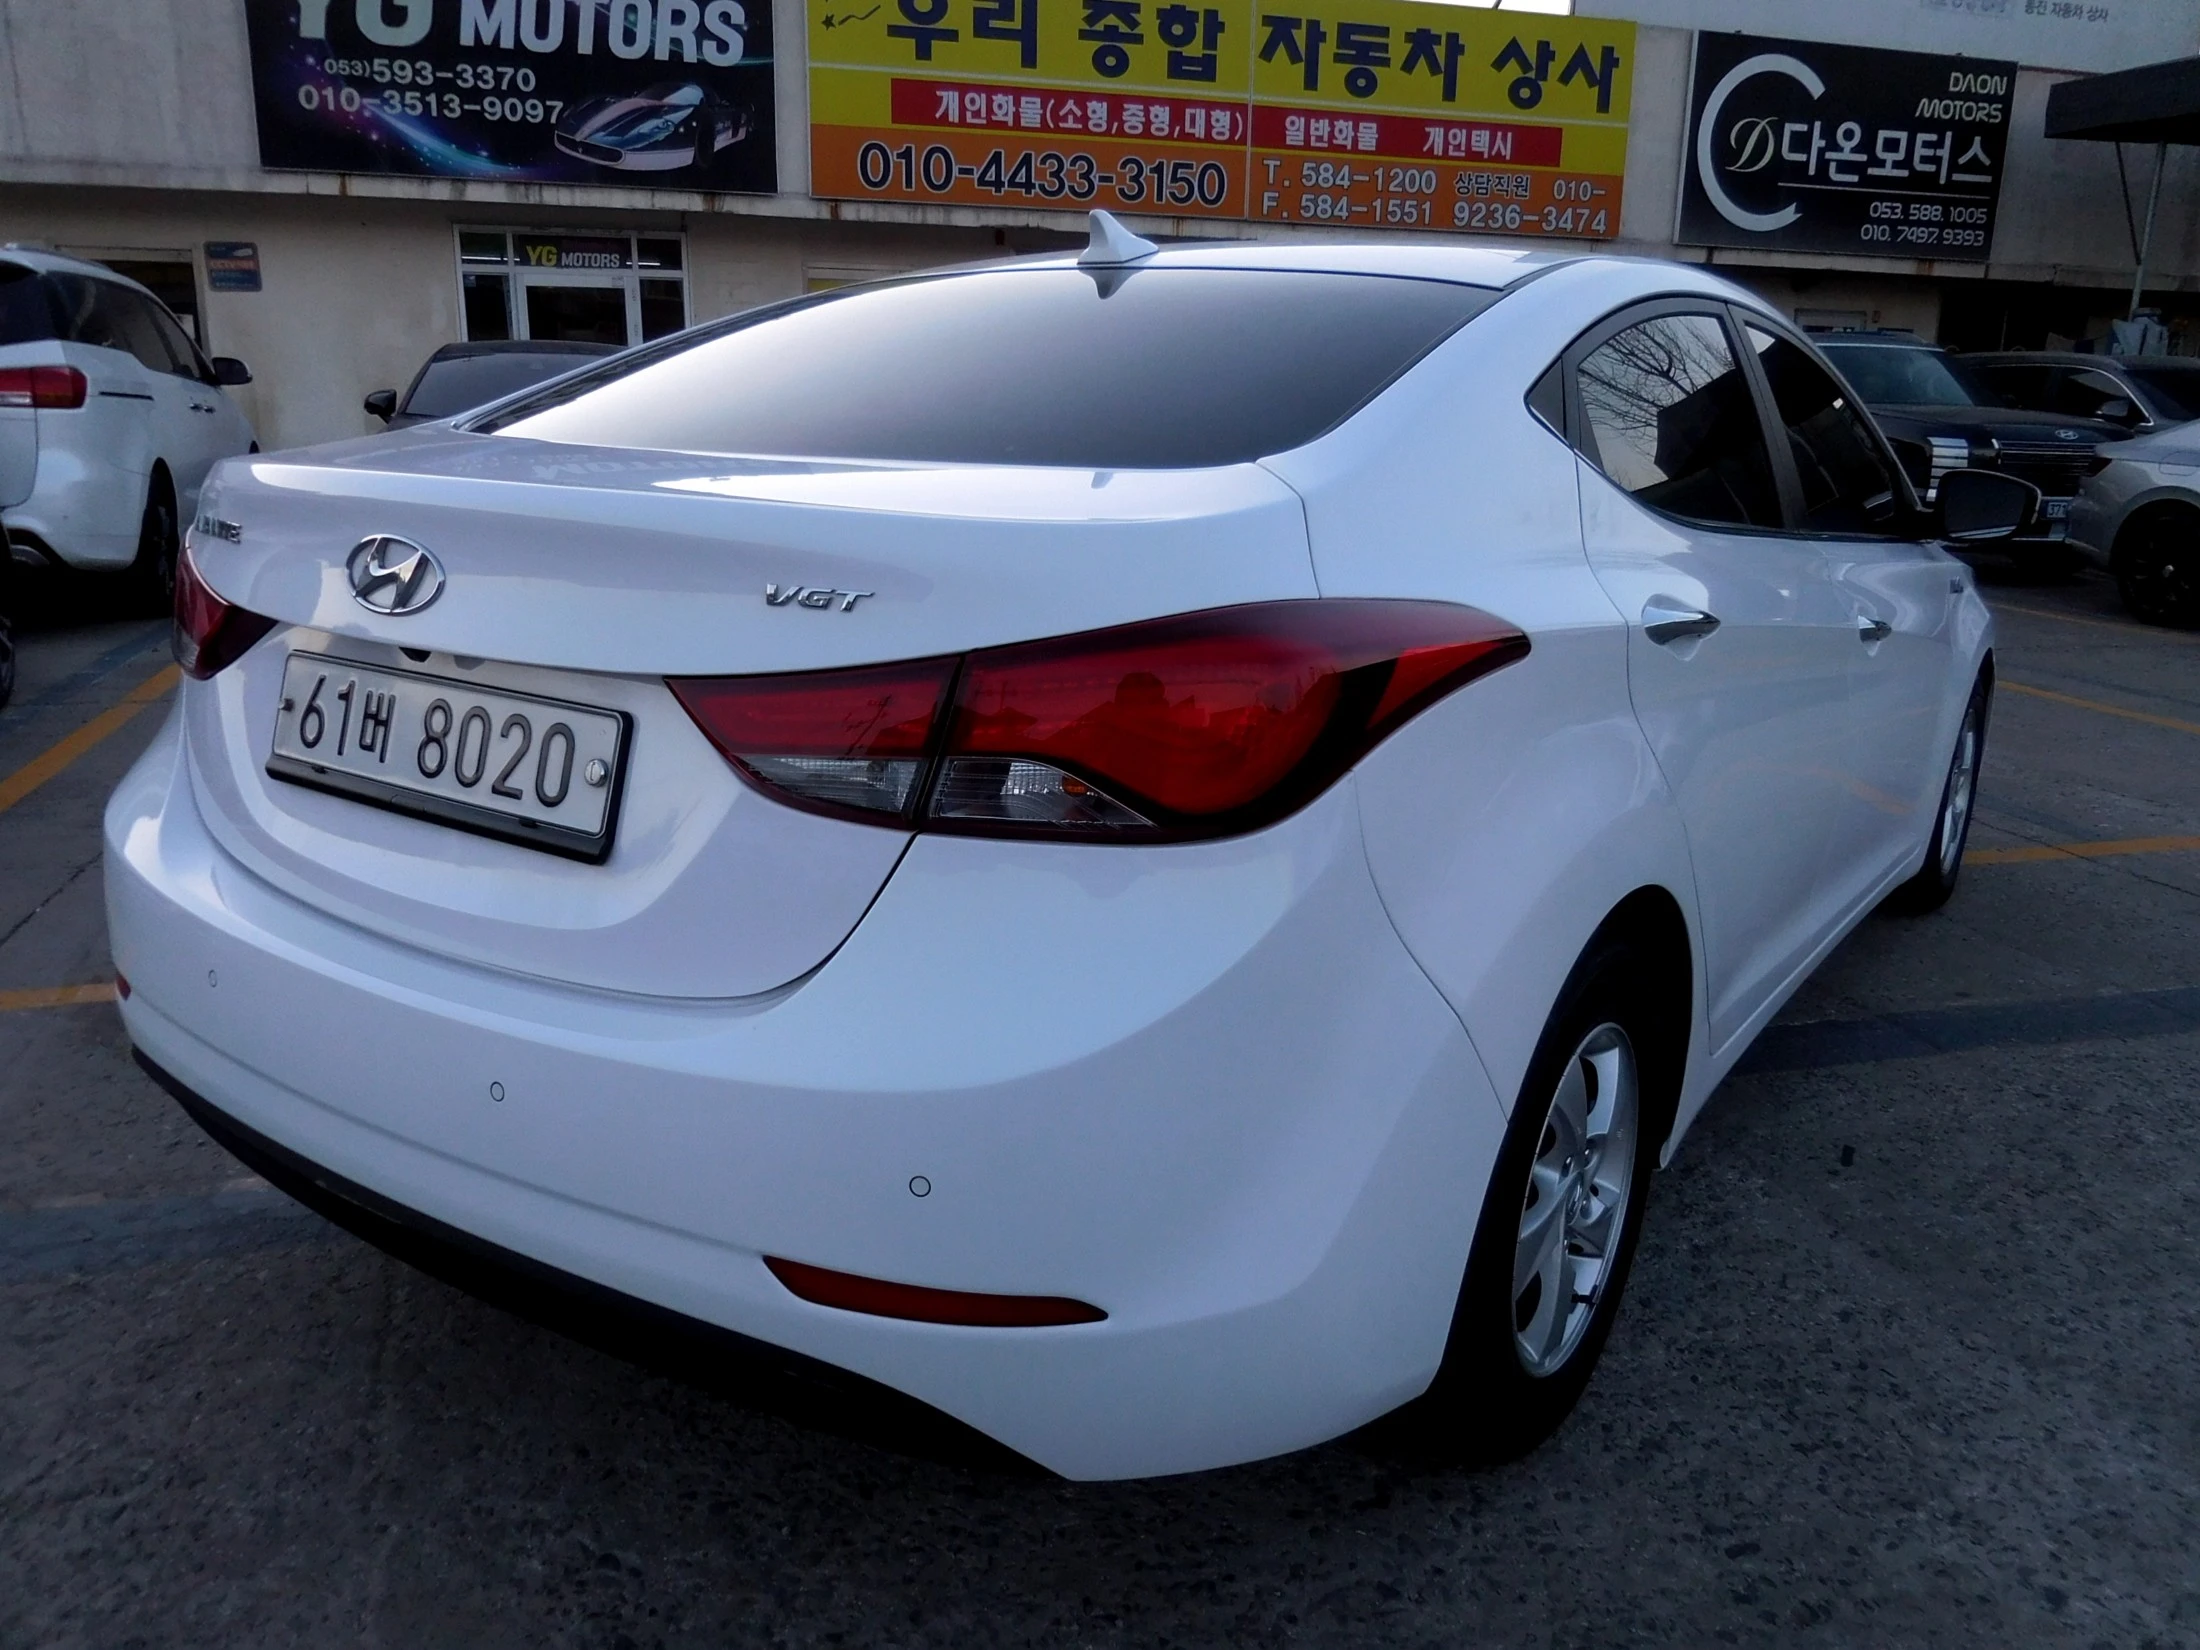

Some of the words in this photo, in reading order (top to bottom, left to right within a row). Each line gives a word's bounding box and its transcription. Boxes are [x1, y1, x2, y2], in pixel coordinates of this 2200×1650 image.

[459, 0, 746, 67] MOTORS
[887, 0, 1038, 69] 우리
[1078, 0, 1226, 83] 종합
[1258, 15, 1465, 102] 자동차
[1490, 36, 1620, 114] 상사
[1948, 72, 2008, 96] DAON
[298, 84, 564, 124] 010-3513-9097
[1914, 97, 2003, 124] MOTORS
[1285, 115, 1379, 151] 일반화물
[1422, 126, 1512, 160] 개인택시
[1781, 121, 1993, 185] 다온모터스
[857, 141, 1227, 208] 010-4433-3150
[1301, 162, 1437, 195] 584-1200
[1453, 171, 1532, 199] 상담직원
[1300, 193, 1432, 225] 584-1551
[1453, 201, 1608, 234] 9236-3474
[1949, 206, 1987, 224] 1005
[1942, 228, 1985, 246] 9393
[525, 245, 558, 267] YG
[561, 252, 620, 268] MOTORS
[766, 583, 876, 612] VGT
[299, 673, 396, 764] 61버
[416, 697, 576, 808] 8020
